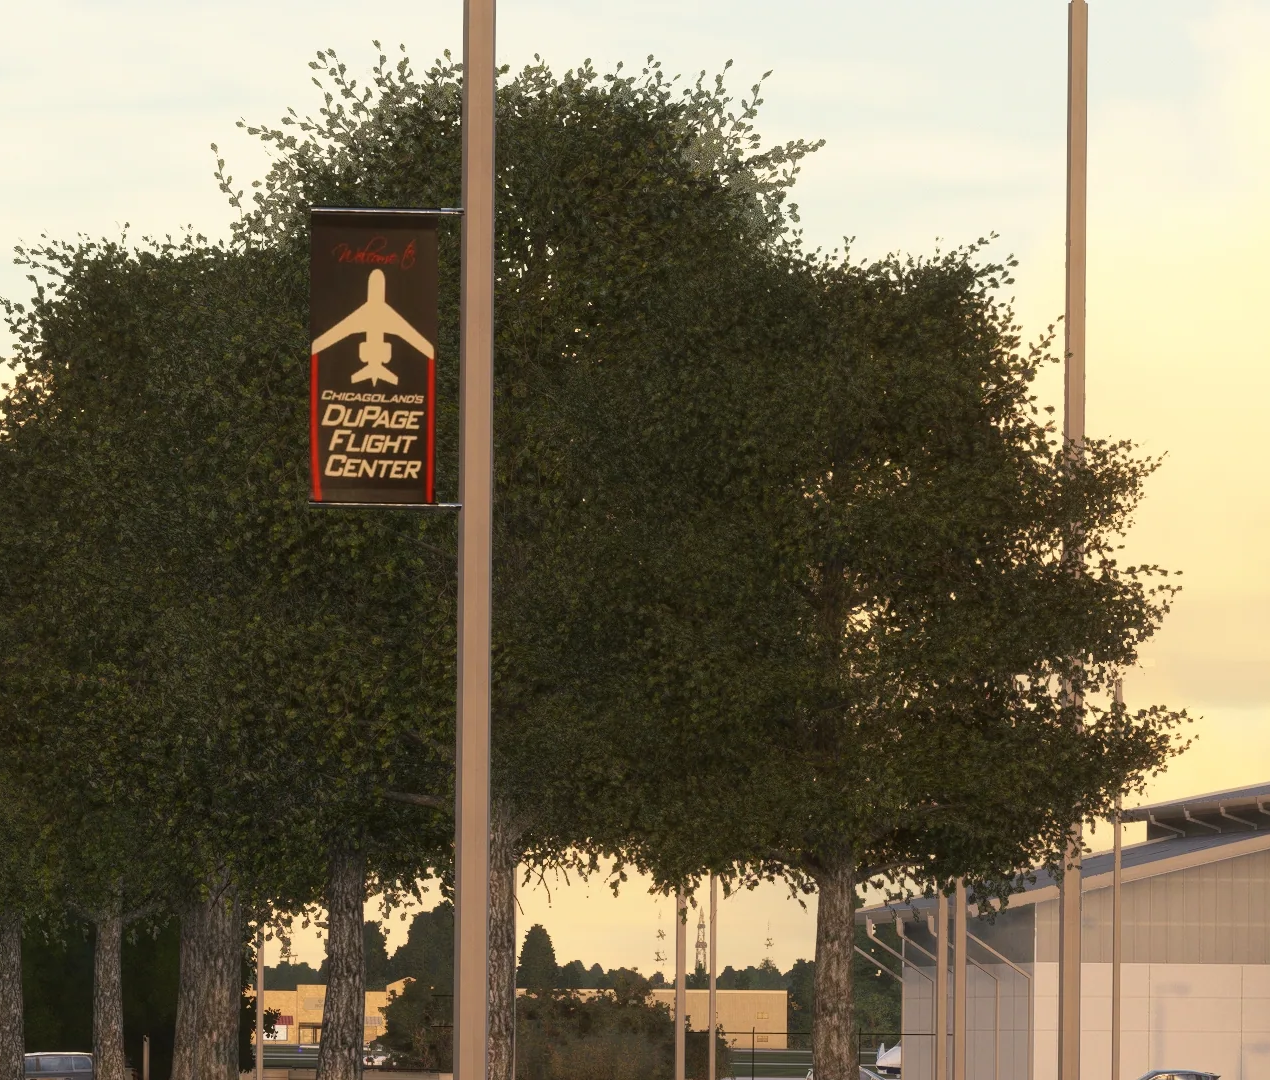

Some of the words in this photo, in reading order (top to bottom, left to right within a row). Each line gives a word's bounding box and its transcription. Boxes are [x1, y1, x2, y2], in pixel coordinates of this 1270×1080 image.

[321, 390, 424, 404] CHICAGOLAND'S
[329, 429, 418, 453] FLIGHT
[324, 454, 422, 479] CENTER
